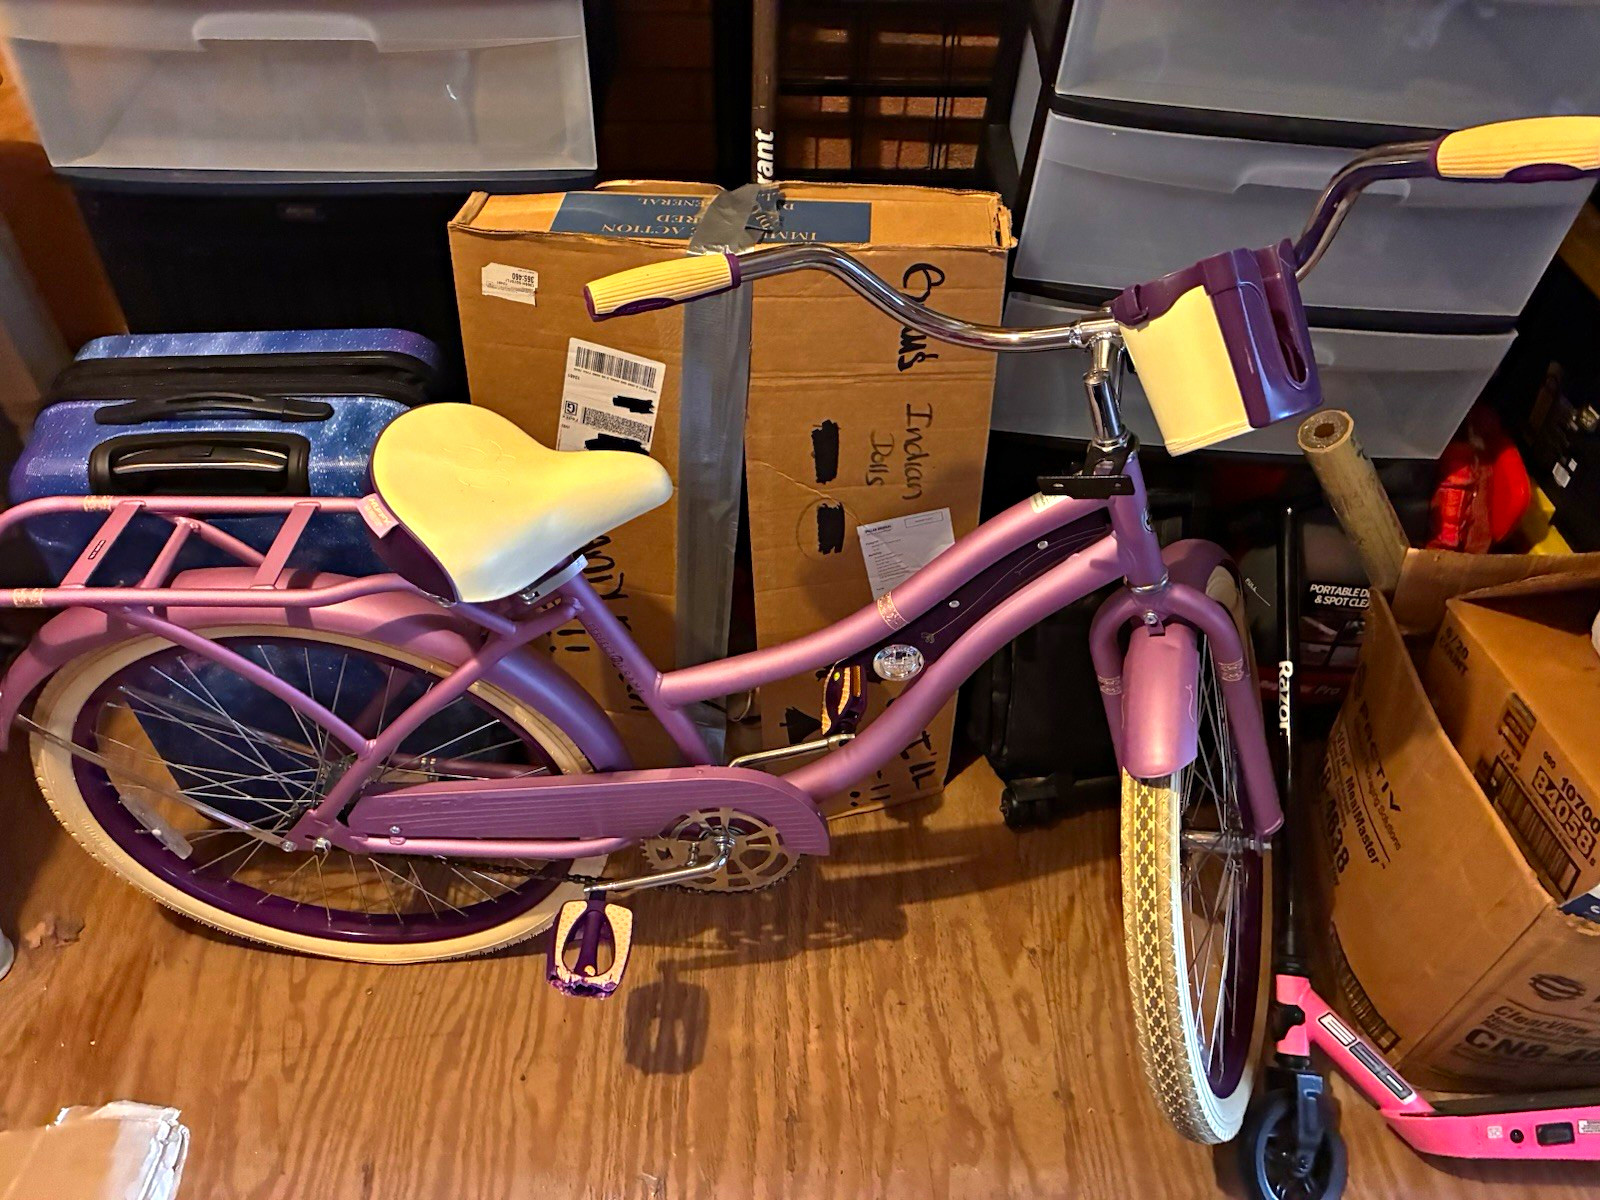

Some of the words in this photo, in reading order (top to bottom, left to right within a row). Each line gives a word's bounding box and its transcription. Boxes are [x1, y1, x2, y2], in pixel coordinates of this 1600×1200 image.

[638, 198, 702, 207] ENERAL
[601, 224, 685, 235] ACTION
[865, 430, 894, 486] Dolls
[902, 403, 933, 500] Indian
[1309, 584, 1360, 597] PORTABLE
[1314, 594, 1323, 604] &
[1323, 595, 1349, 606] SPOT
[1533, 768, 1594, 856] 84058
[1560, 776, 1600, 835] 10700
